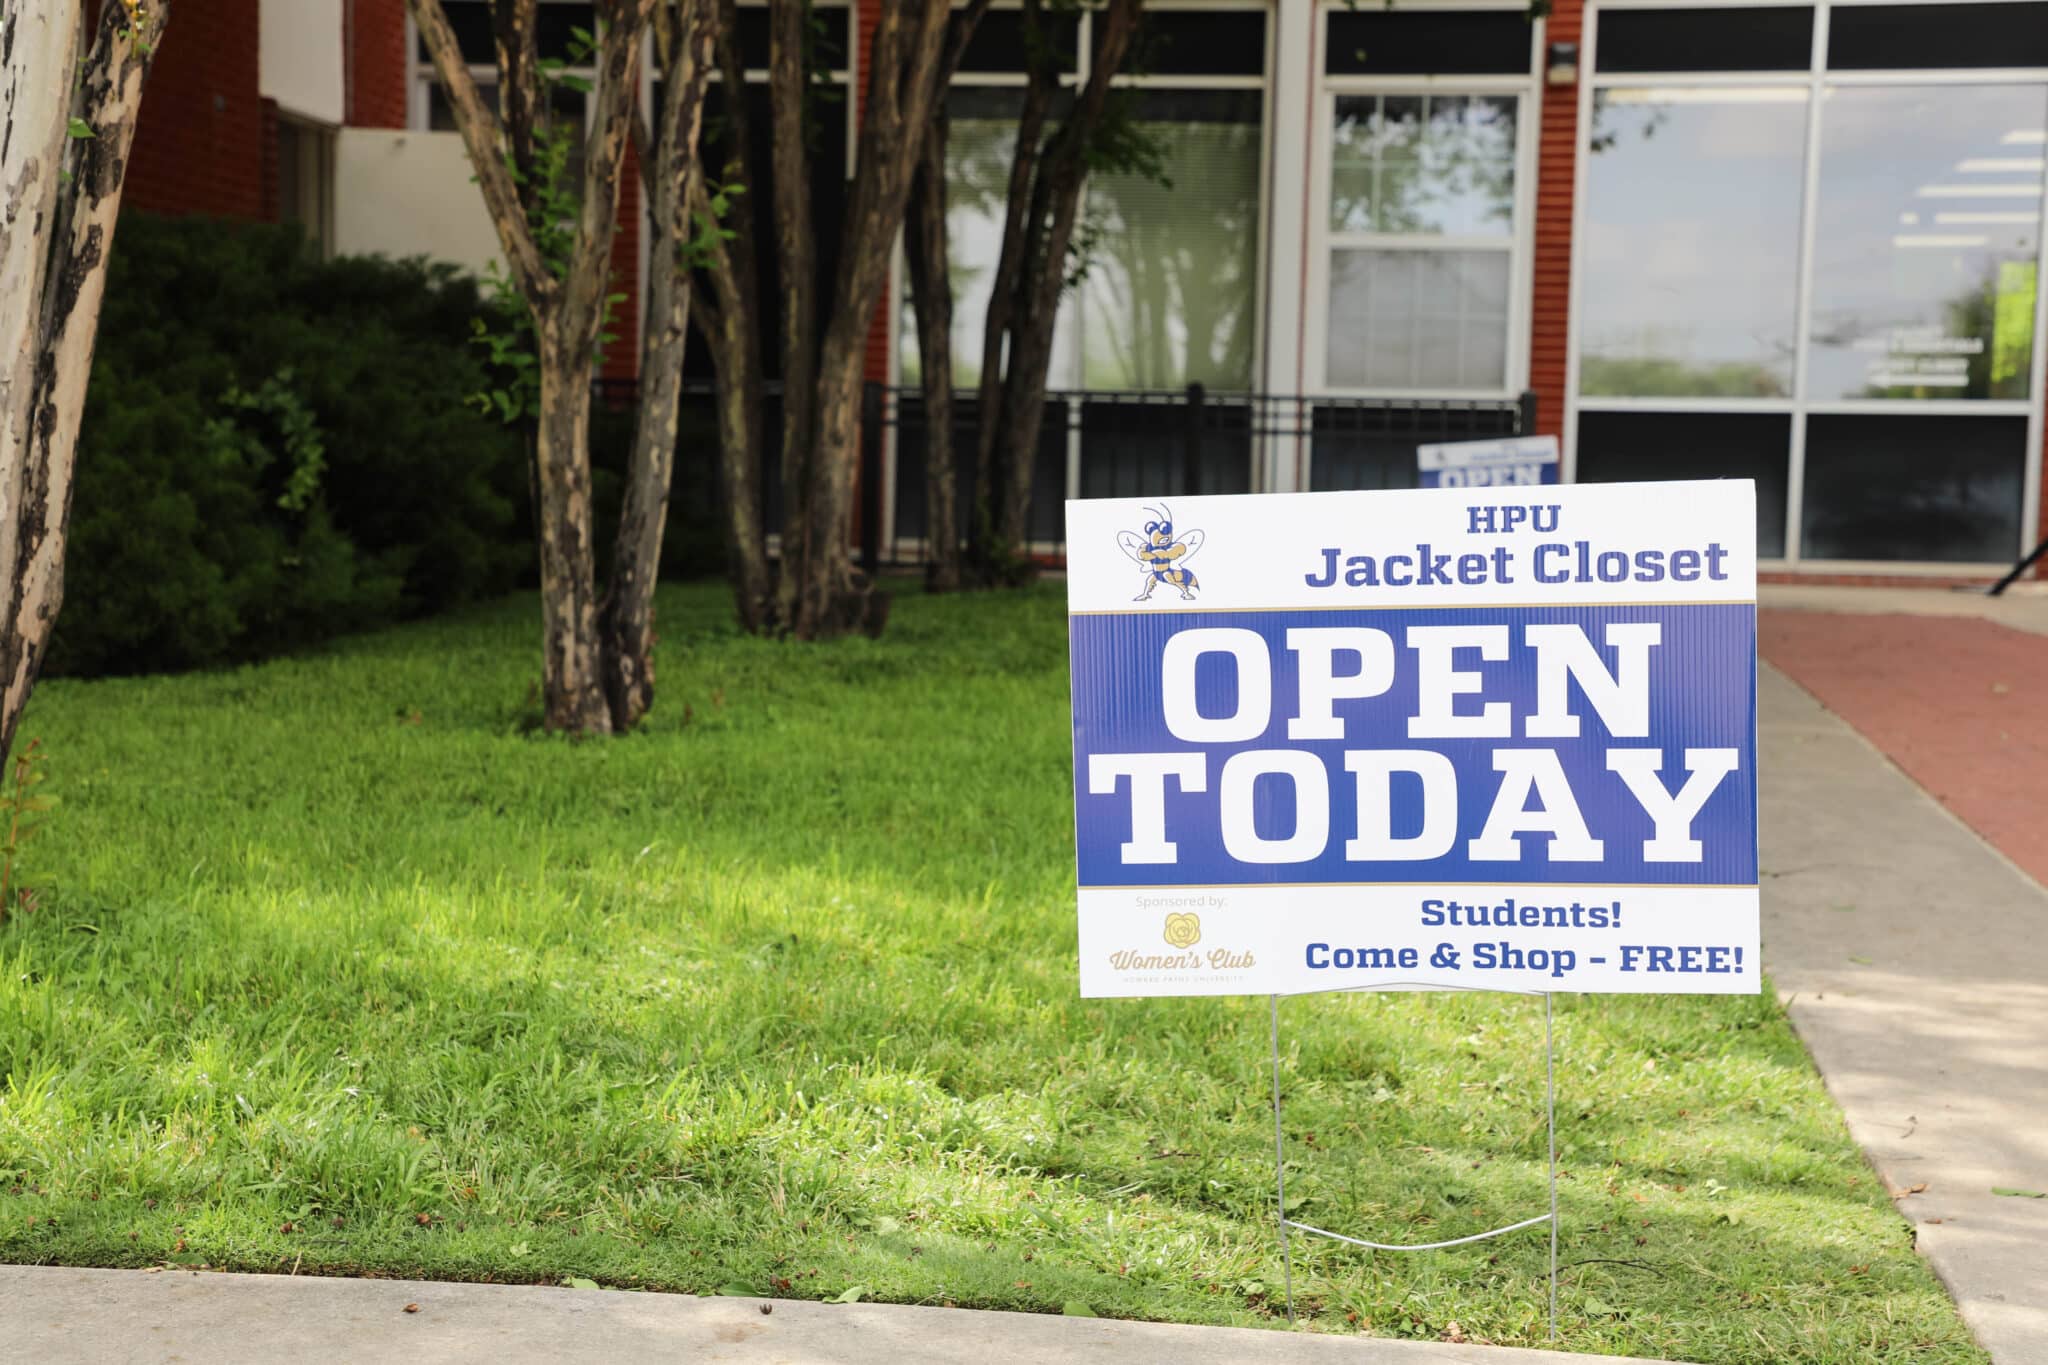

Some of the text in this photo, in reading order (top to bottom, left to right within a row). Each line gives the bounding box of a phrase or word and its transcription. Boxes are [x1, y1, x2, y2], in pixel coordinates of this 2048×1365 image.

[1467, 505, 1561, 533] HPU
[1305, 540, 1728, 588] Jacket Closet
[1162, 622, 1662, 743] OPEN
[1088, 748, 1739, 865] TODAY
[1135, 896, 1205, 909] Sponsored
[1421, 899, 1622, 929] Students!
[1109, 948, 1257, 970] Women's Club
[1305, 942, 1419, 970] Come
[1429, 942, 1461, 970] &
[1472, 941, 1577, 978] Shop
[1619, 945, 1744, 973] FREE!
